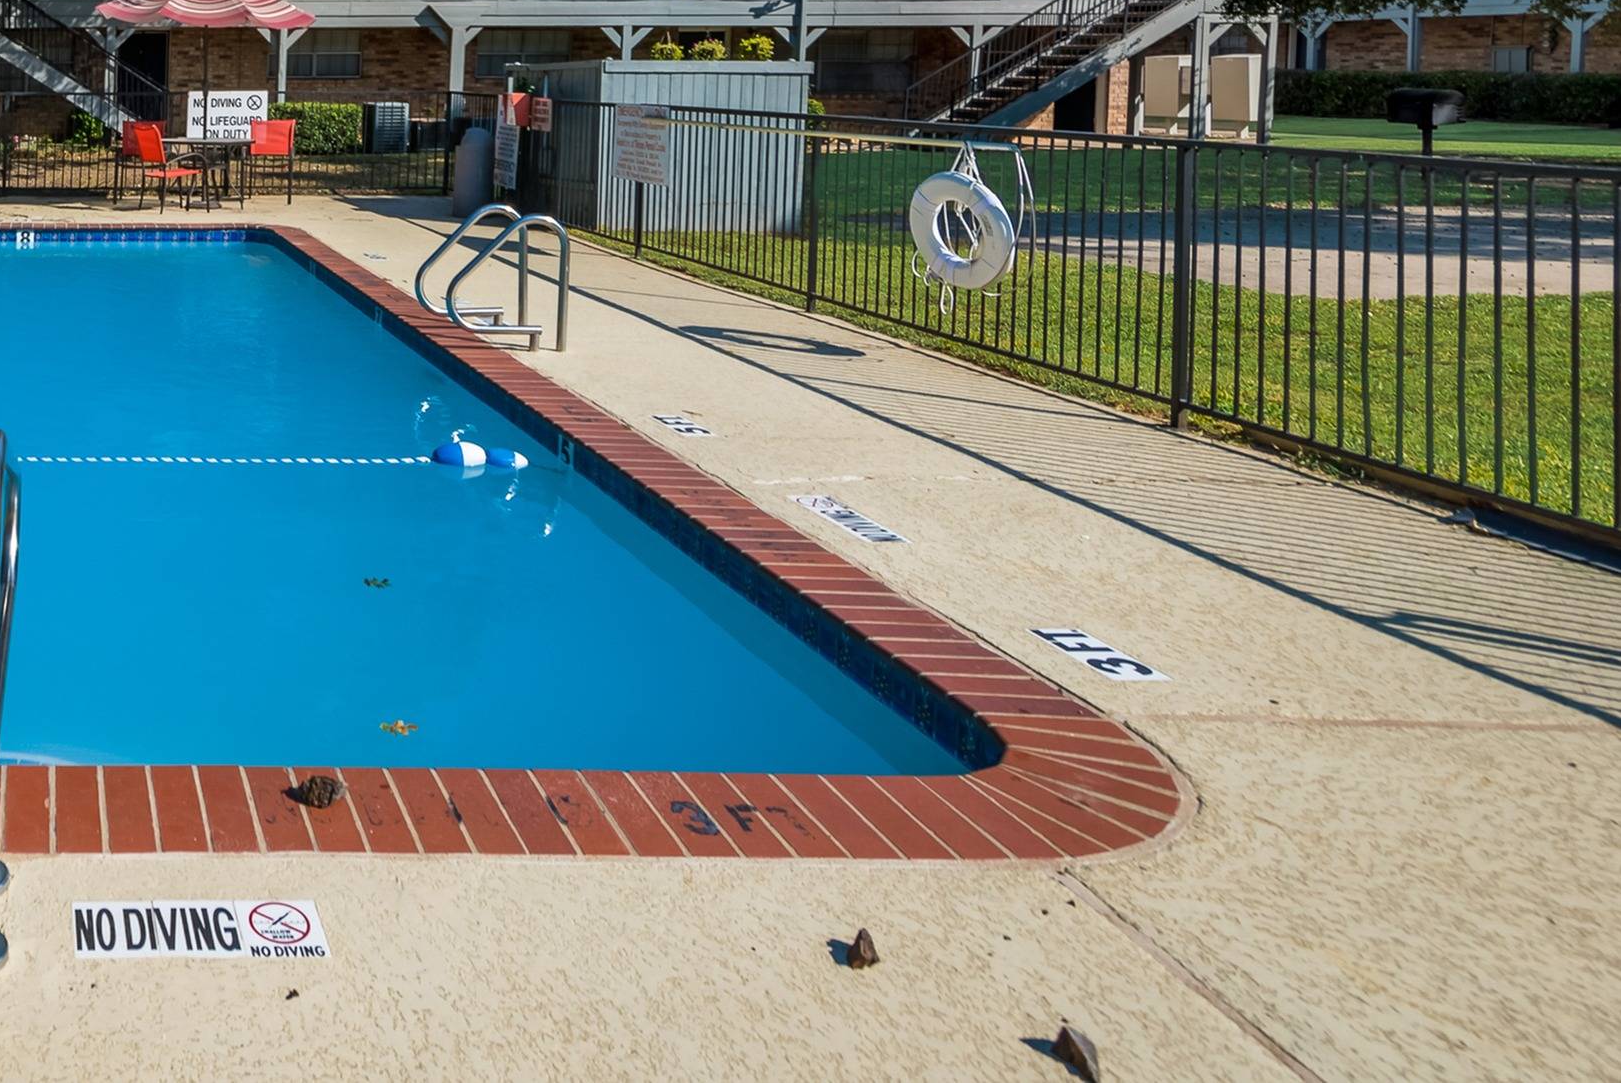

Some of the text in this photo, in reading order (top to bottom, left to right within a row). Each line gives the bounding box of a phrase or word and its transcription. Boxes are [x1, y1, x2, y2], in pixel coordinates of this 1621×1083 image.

[193, 98, 242, 108] NO DIVING
[192, 116, 204, 127] NO
[223, 129, 248, 139] DUTY
[20, 231, 30, 244] 8
[562, 438, 571, 465] 5
[1086, 657, 1153, 676] 3
[670, 800, 720, 836] 3
[75, 908, 242, 951] NO DIVING
[250, 946, 325, 957] NO DIVING
